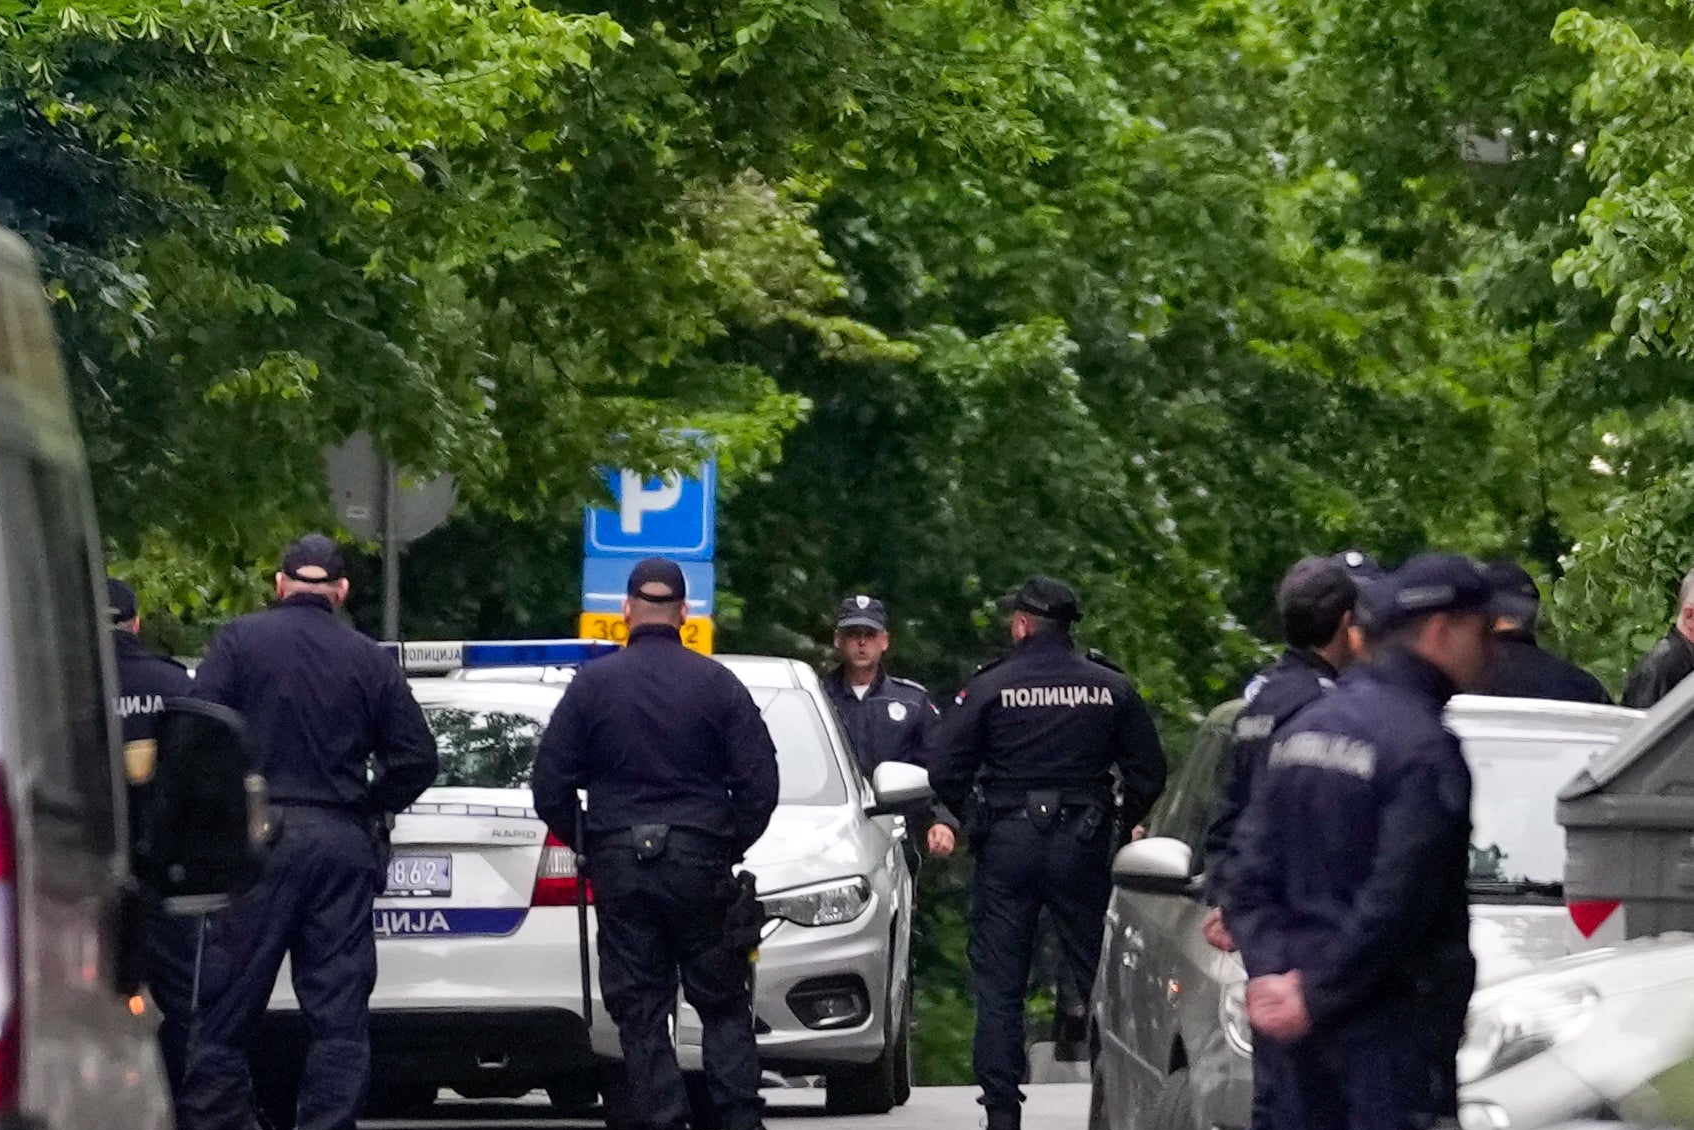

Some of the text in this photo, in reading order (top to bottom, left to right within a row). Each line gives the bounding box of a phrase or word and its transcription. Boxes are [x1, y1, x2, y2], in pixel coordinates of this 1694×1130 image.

[620, 467, 682, 534] P
[684, 624, 700, 643] 2
[113, 694, 166, 718] ЦИЈА
[1000, 686, 1114, 708] ПОЛИЦИЈА
[373, 910, 451, 937] ЦИЈА
